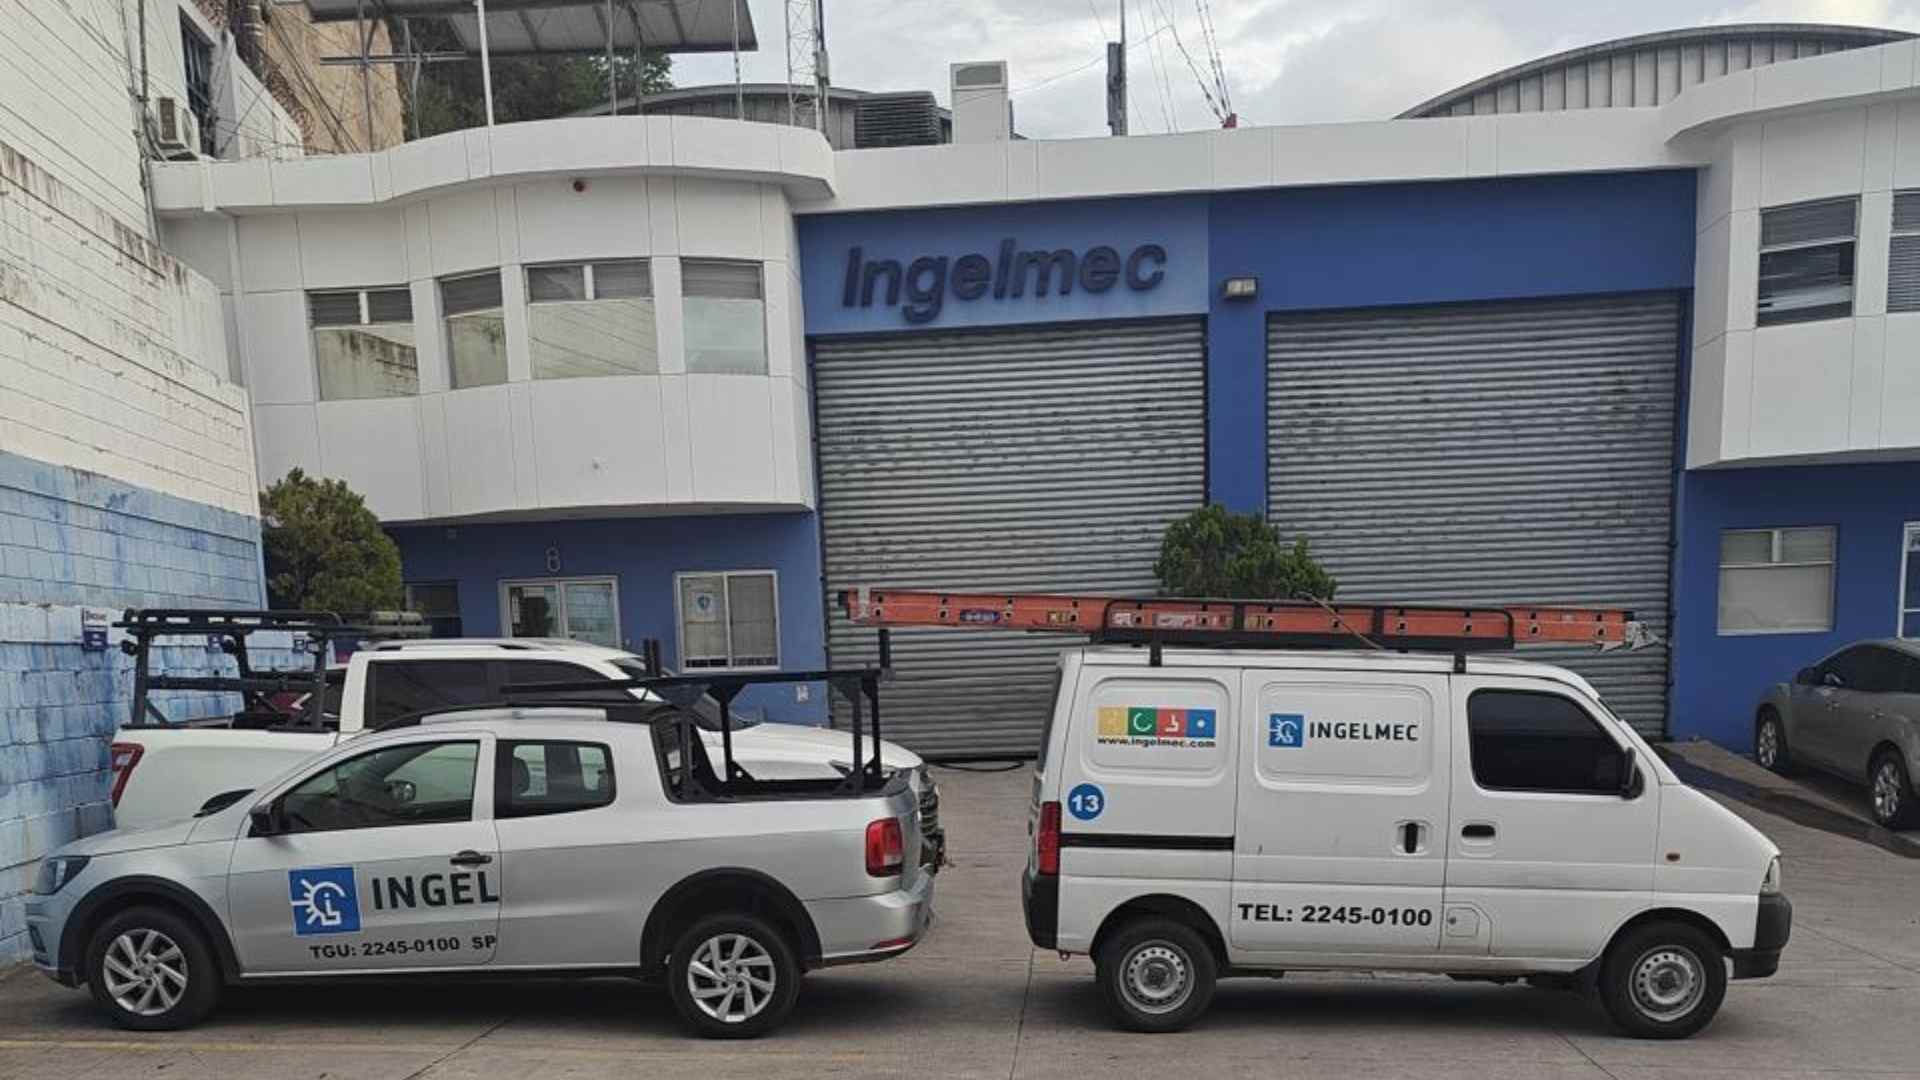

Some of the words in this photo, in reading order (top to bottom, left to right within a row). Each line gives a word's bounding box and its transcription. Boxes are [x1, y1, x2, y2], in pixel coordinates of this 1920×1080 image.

[842, 238, 1167, 323] Ingelmec
[1097, 736, 1217, 748] www.ingelmec.com
[1309, 722, 1419, 741] INGELMEC
[1071, 794, 1100, 812] 13
[372, 871, 499, 910] INGEL
[1238, 904, 1293, 922] TEL:
[1301, 905, 1433, 926] 2245-0100
[309, 944, 357, 959] TGU:
[362, 936, 461, 957] 2245-0100
